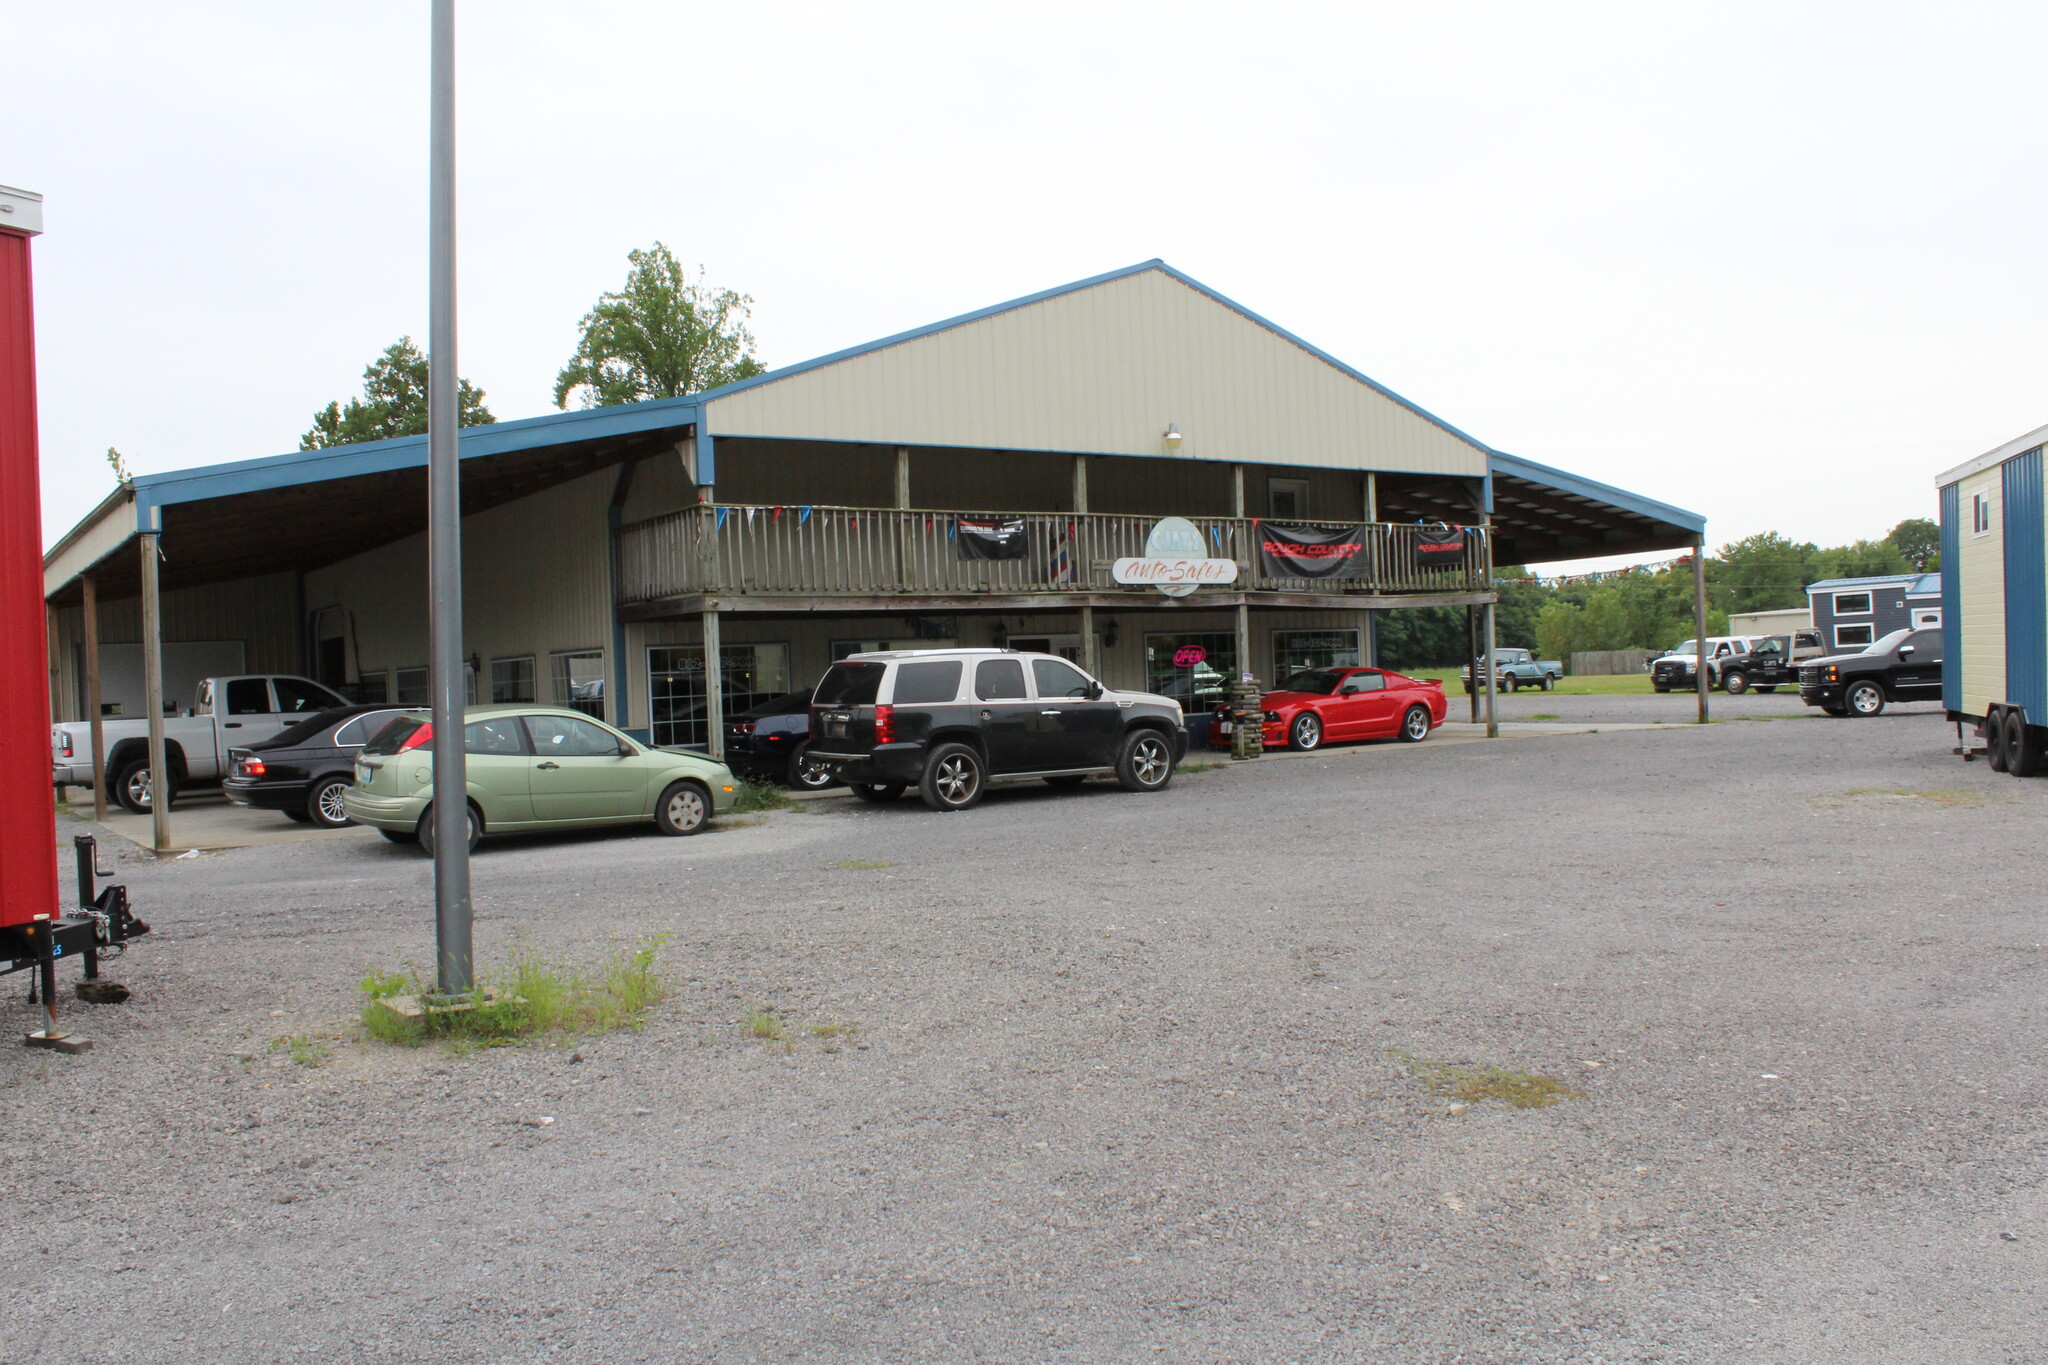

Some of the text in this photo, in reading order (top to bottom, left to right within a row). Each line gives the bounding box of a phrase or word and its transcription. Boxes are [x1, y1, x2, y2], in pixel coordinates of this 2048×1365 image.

[1263, 542, 1362, 554] ROUGH COUNTRY
[1175, 649, 1202, 662] OPEN
